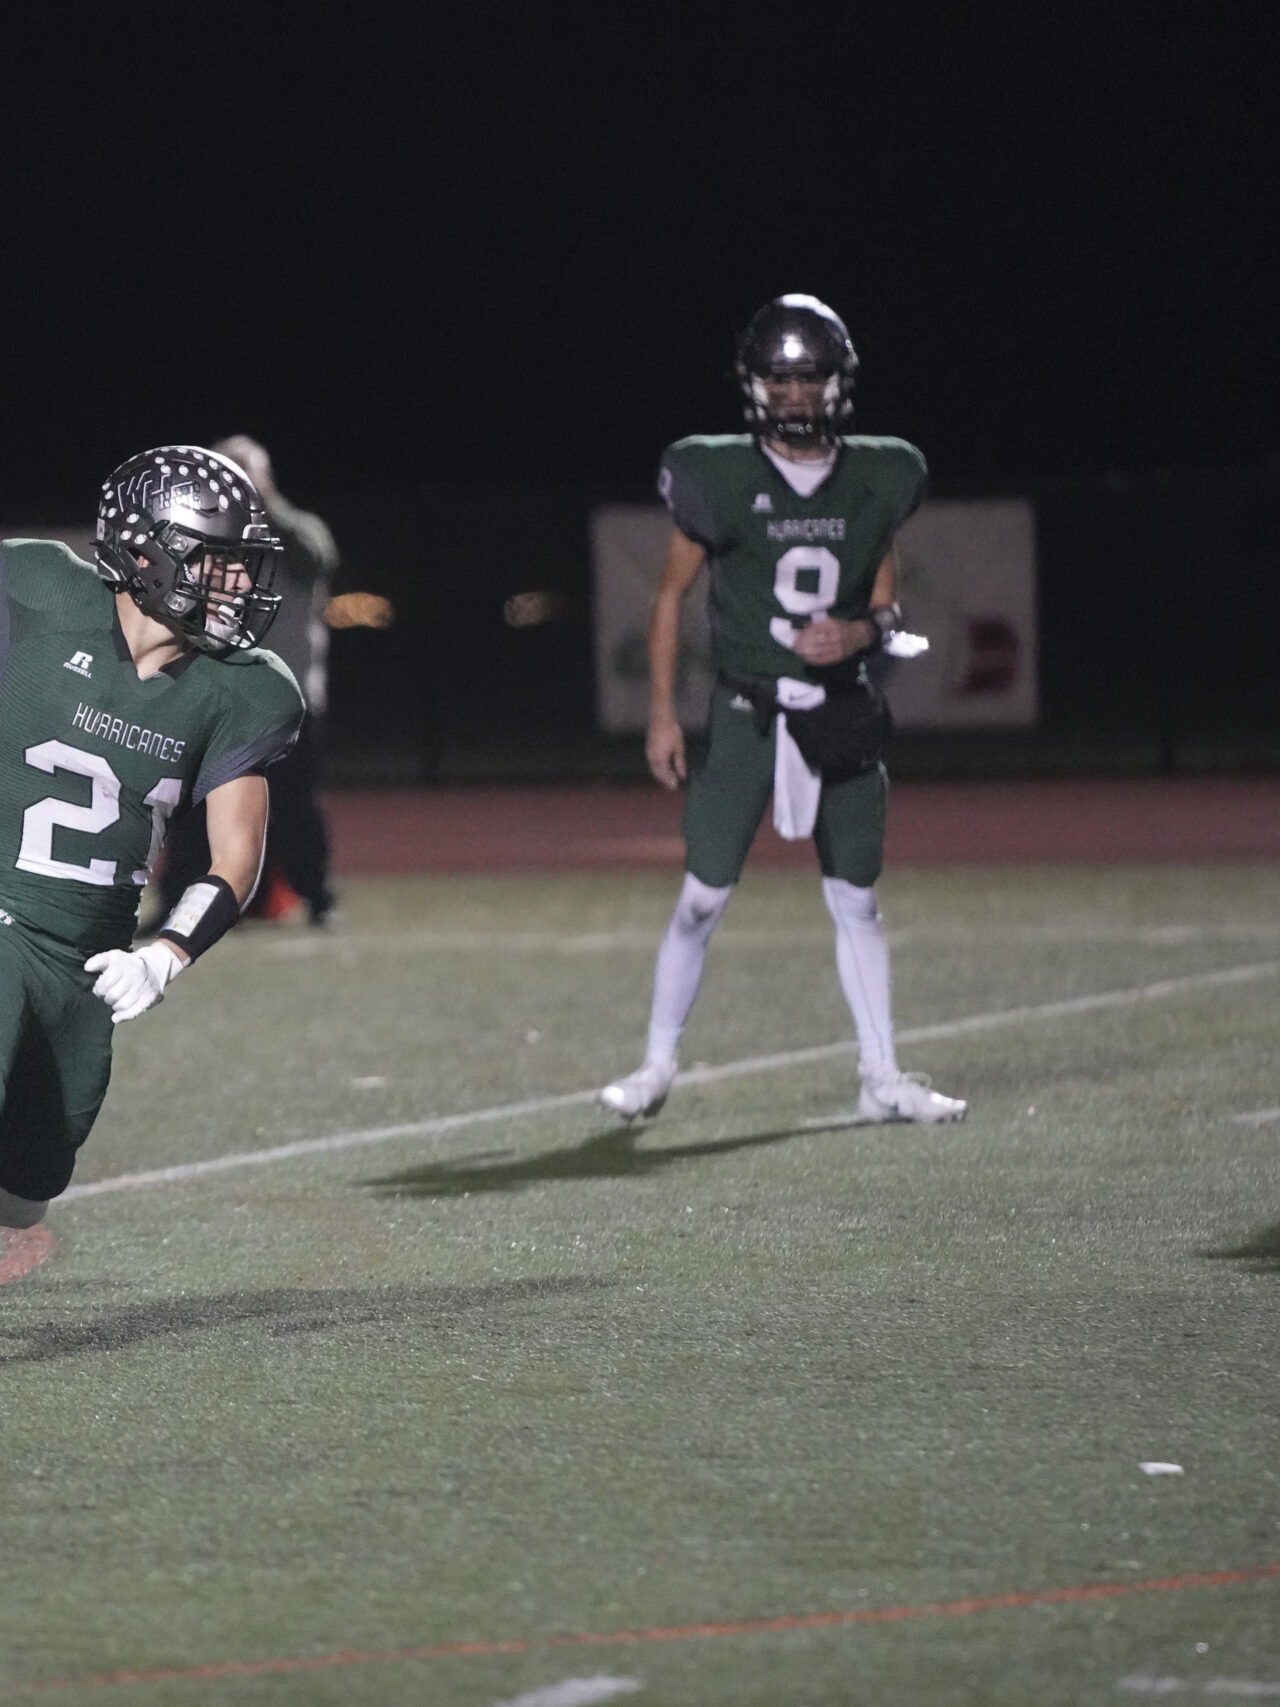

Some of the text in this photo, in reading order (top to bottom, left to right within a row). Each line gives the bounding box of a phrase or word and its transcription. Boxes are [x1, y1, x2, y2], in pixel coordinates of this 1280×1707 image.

[767, 518, 846, 541] HURRICANES
[769, 545, 841, 650] 9
[72, 702, 186, 763] HURRICANES
[15, 739, 183, 886] 21
